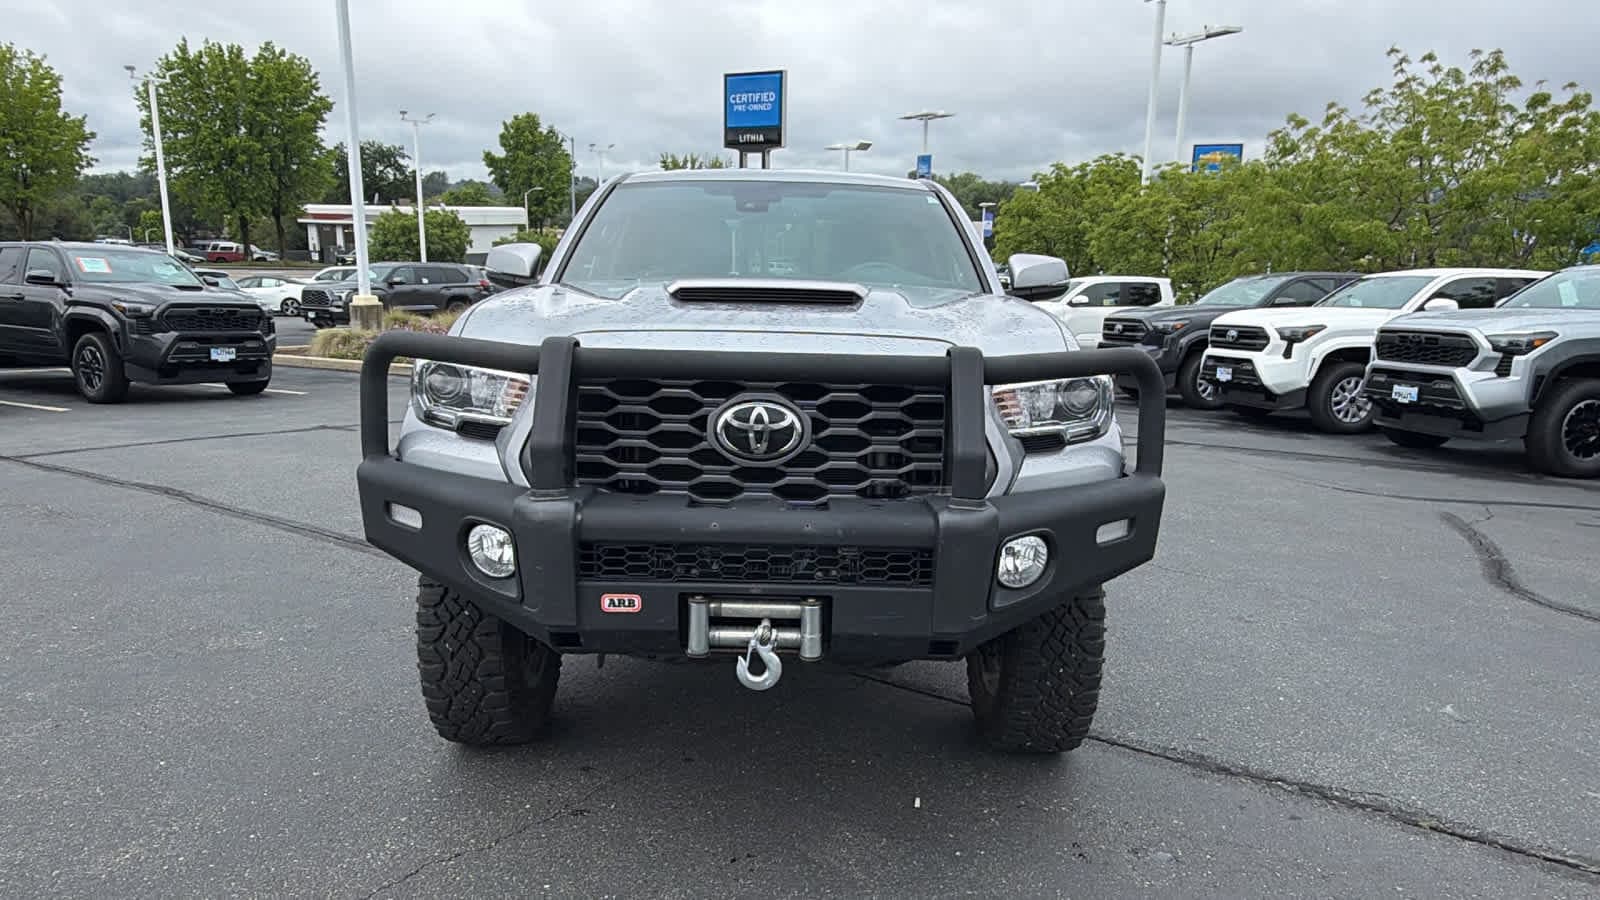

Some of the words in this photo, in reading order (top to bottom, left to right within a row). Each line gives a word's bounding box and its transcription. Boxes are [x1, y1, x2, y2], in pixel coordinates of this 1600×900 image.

[729, 91, 776, 104] CERTIFIED
[733, 103, 772, 112] PRE-OWNED
[738, 133, 765, 143] LITHIA
[607, 598, 636, 608] ARB
